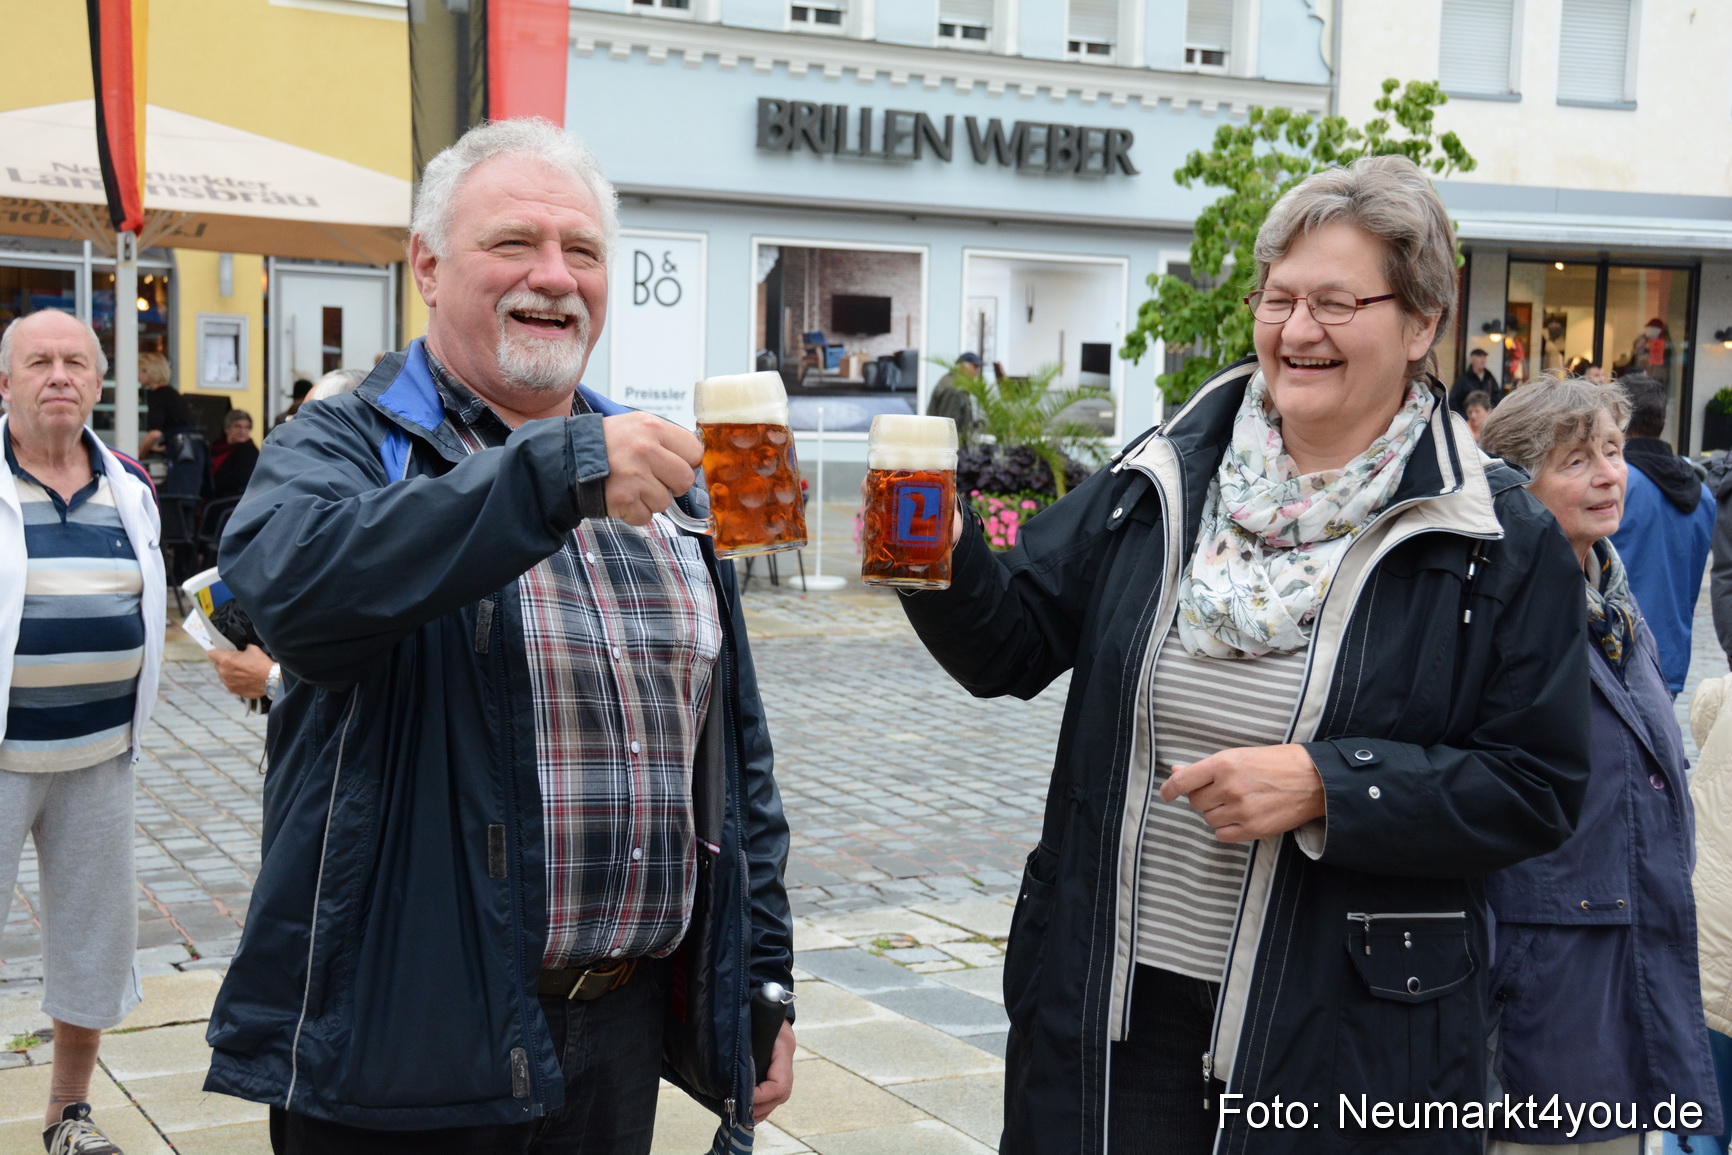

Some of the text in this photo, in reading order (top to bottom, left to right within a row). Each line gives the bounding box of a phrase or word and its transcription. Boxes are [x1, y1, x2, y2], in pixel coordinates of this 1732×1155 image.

[756, 97, 1141, 178] BRILLEN WEBER
[625, 386, 687, 400] Preissler
